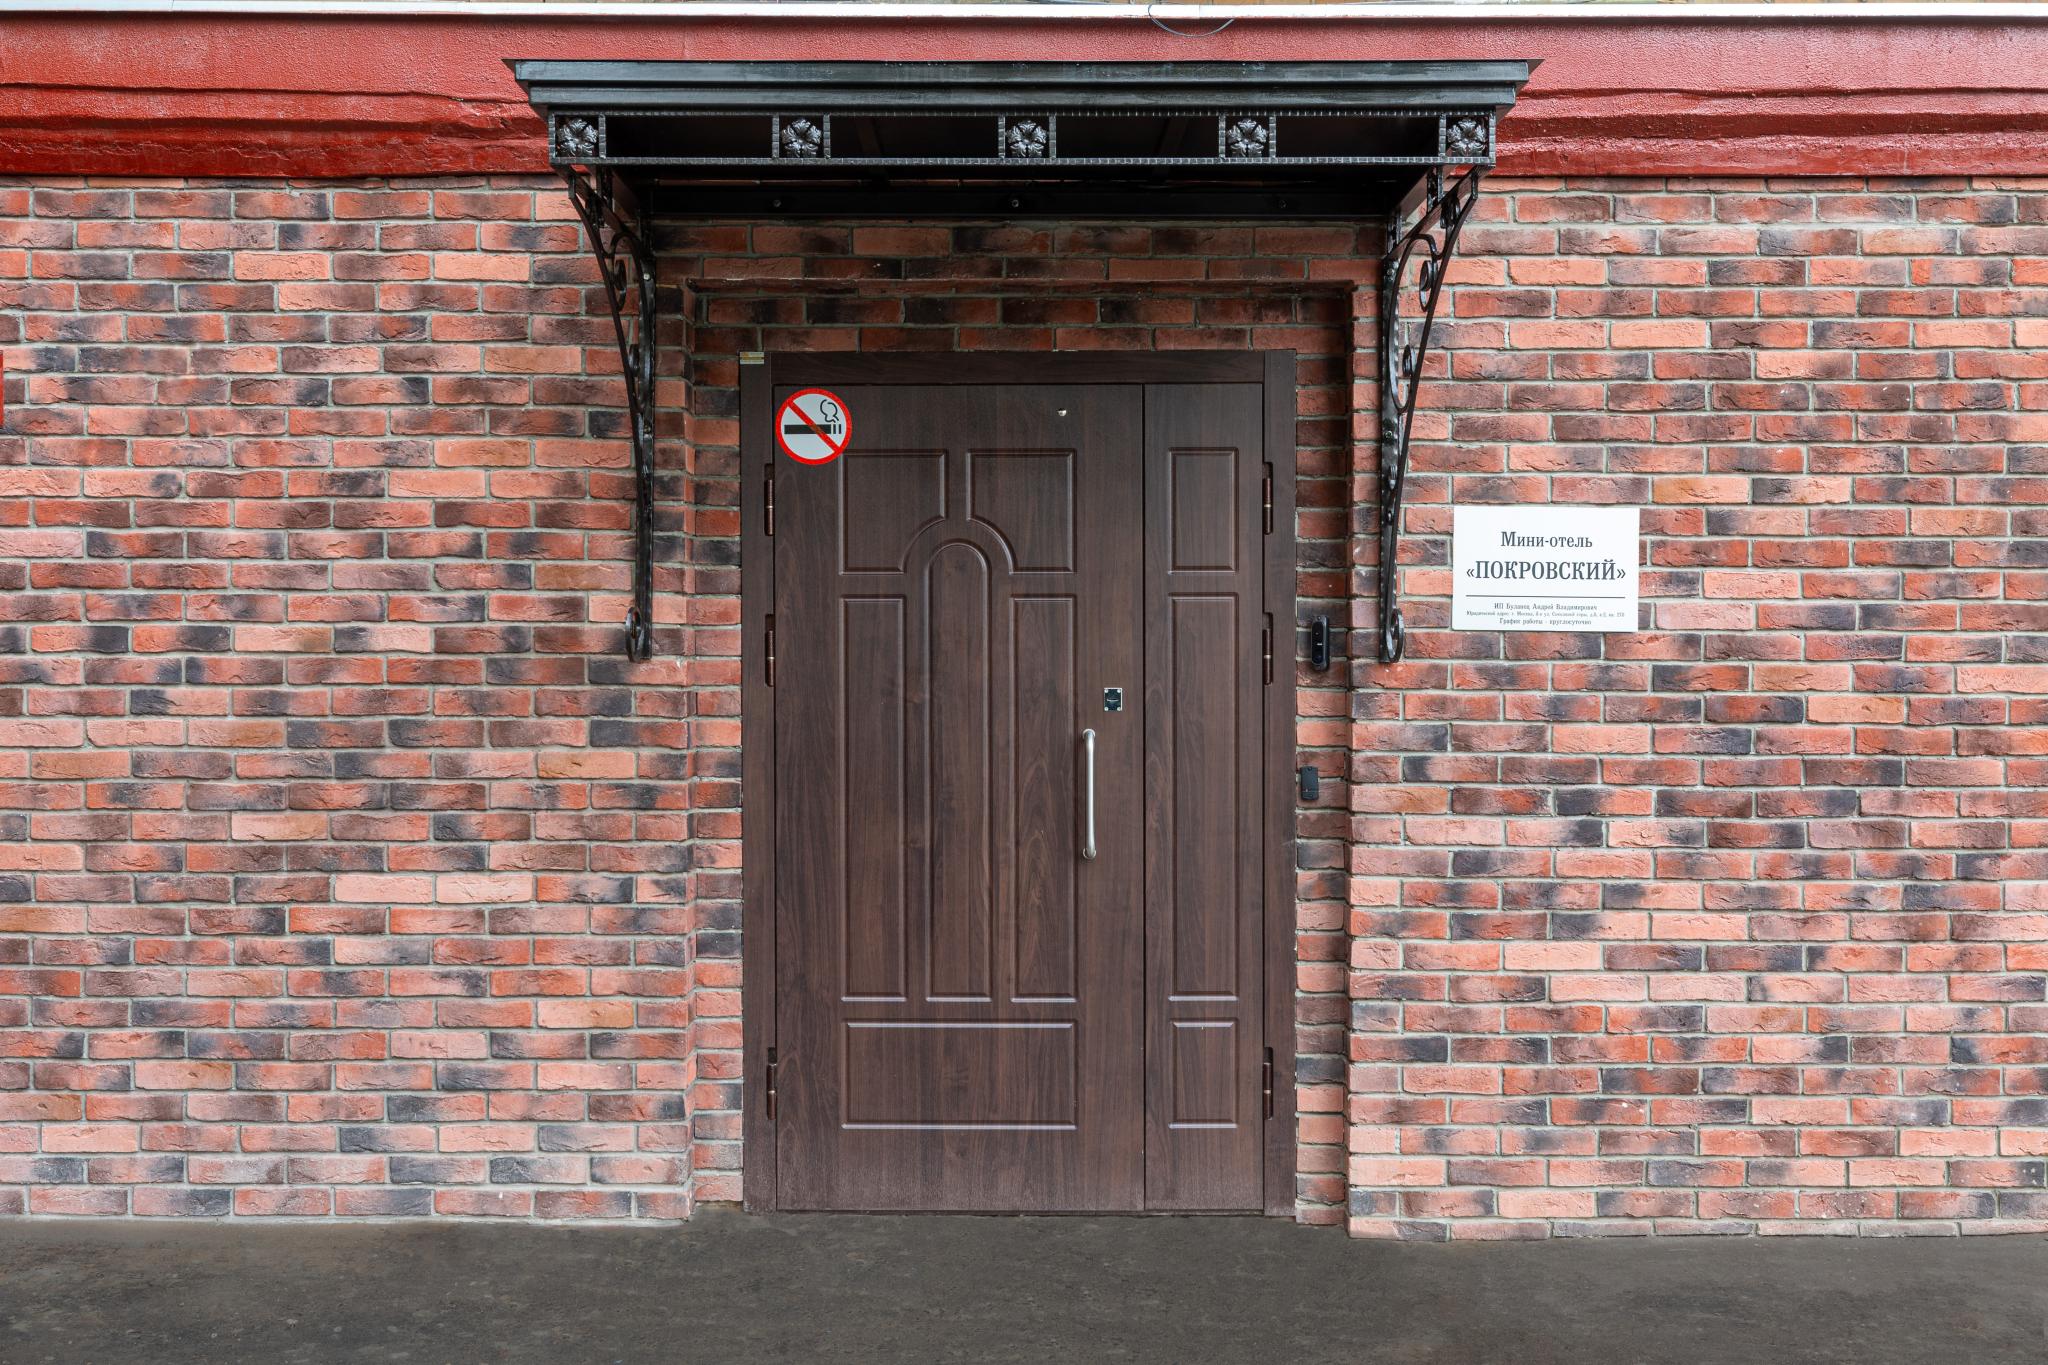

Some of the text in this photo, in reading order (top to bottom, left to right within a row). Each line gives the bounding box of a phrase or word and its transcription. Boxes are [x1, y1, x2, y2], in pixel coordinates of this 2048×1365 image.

[1501, 531, 1593, 548] Мини-отель
[1466, 559, 1626, 580] «ПОКРОВСКИЙ»
[1533, 603, 1554, 611] Андрей
